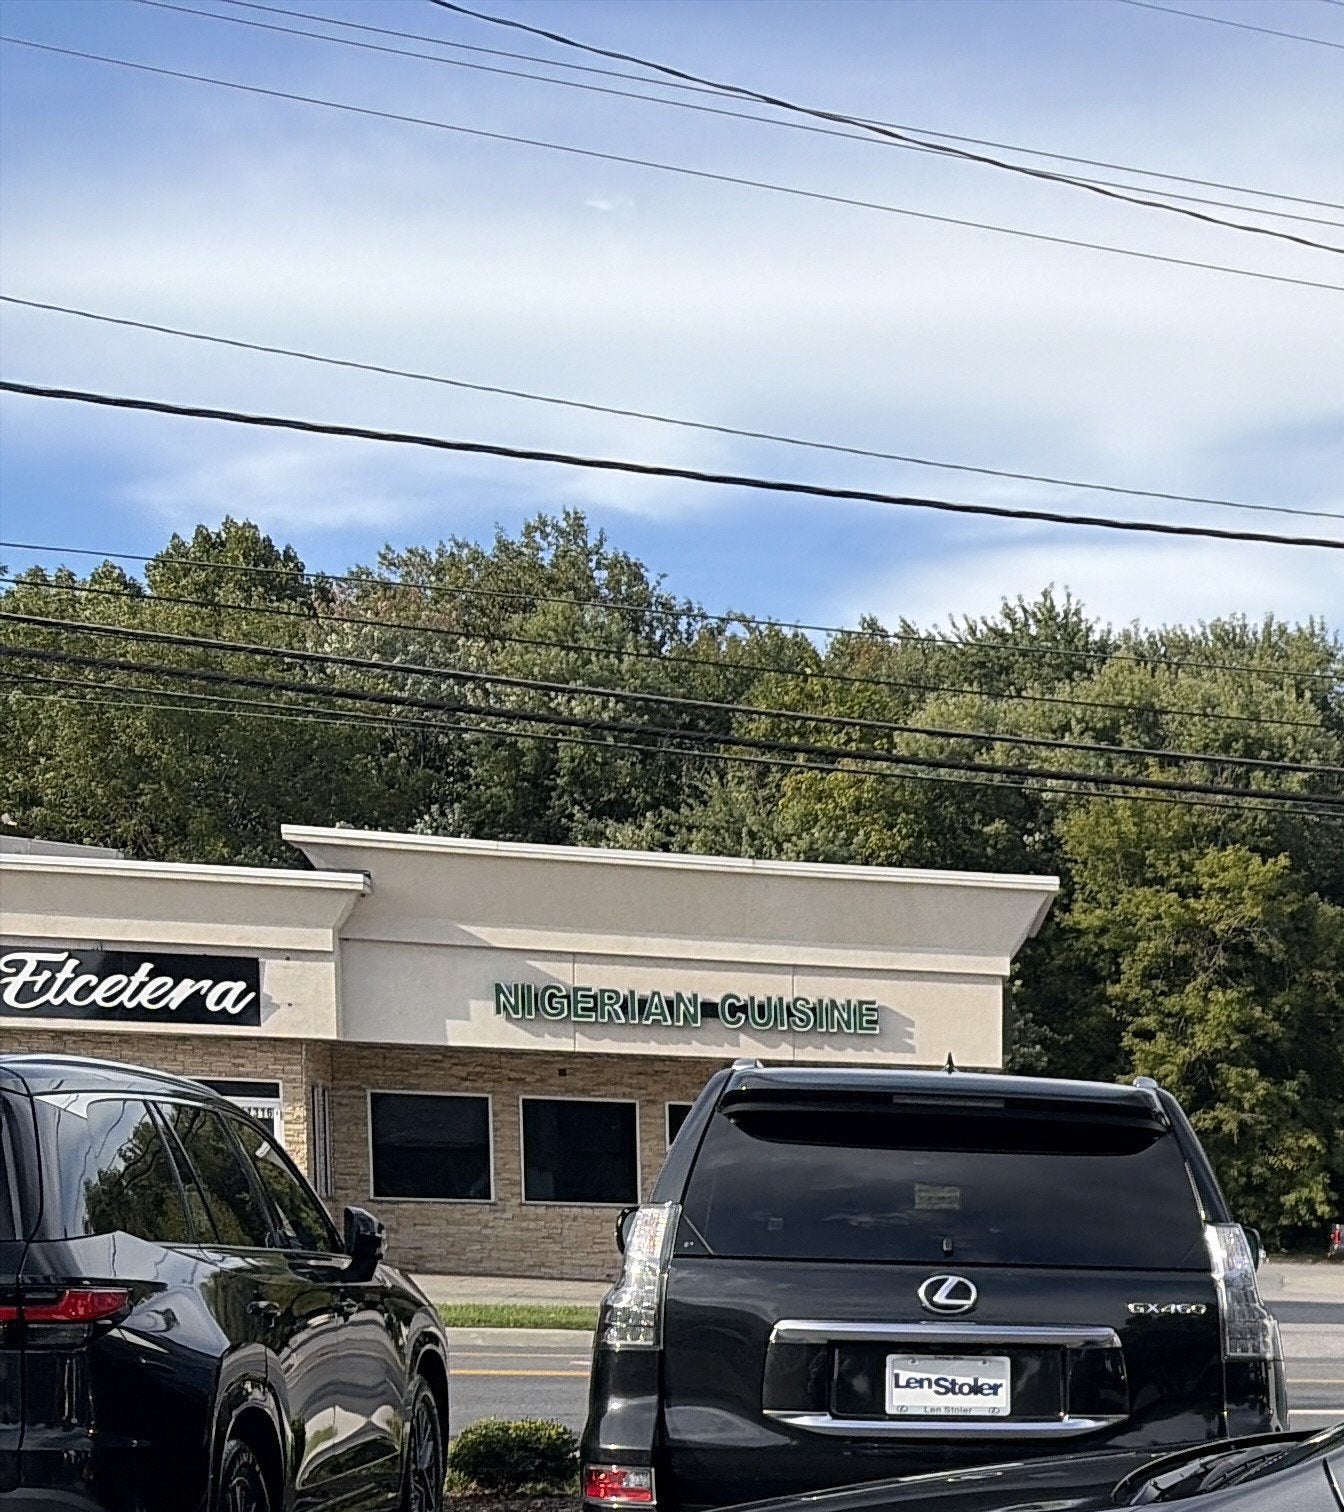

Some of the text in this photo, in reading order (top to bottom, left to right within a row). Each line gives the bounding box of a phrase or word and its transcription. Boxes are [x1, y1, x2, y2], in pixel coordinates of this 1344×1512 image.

[0, 951, 256, 1014] Etcetera
[494, 982, 880, 1035] NIGERIAN CUISINE
